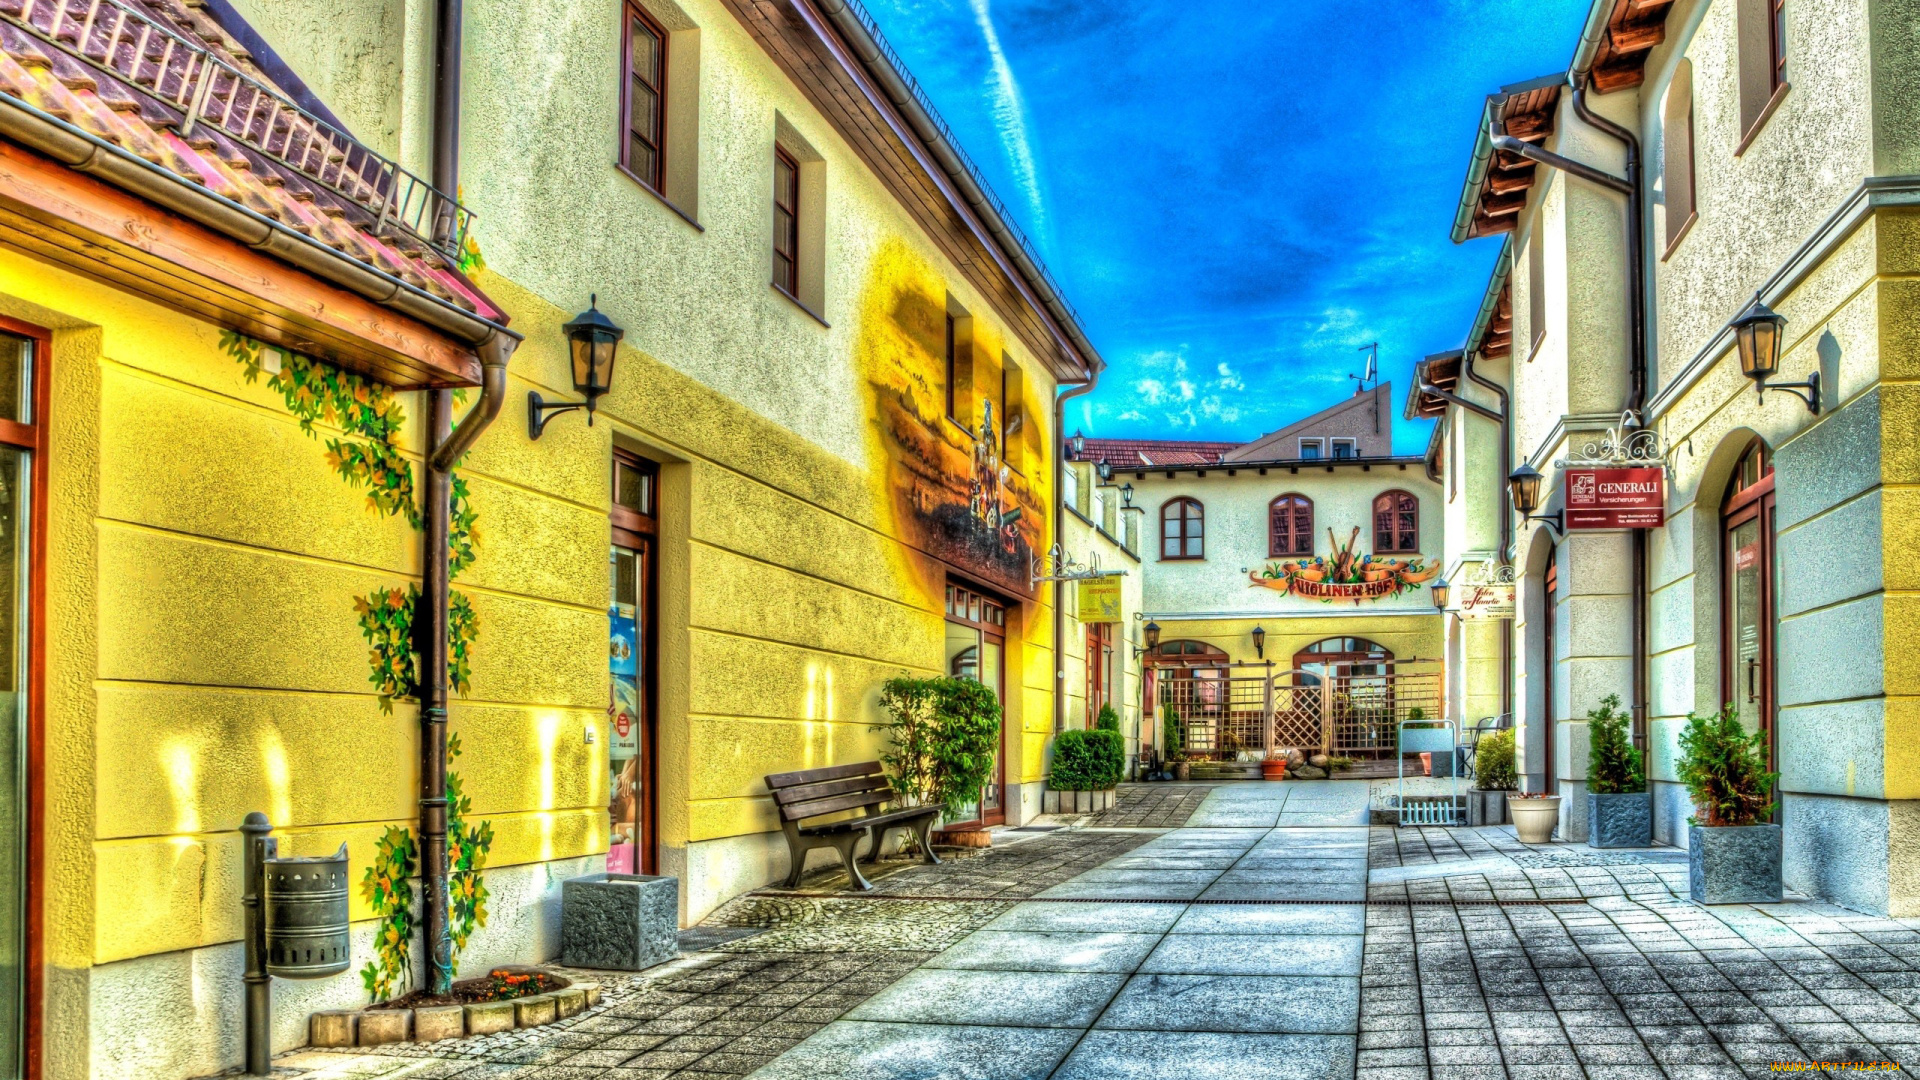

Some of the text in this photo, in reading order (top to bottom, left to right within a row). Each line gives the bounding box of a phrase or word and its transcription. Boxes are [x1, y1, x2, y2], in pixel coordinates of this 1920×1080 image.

[1598, 482, 1658, 494] GENERALI
[1295, 578, 1393, 596] VIOLINEN HOF
